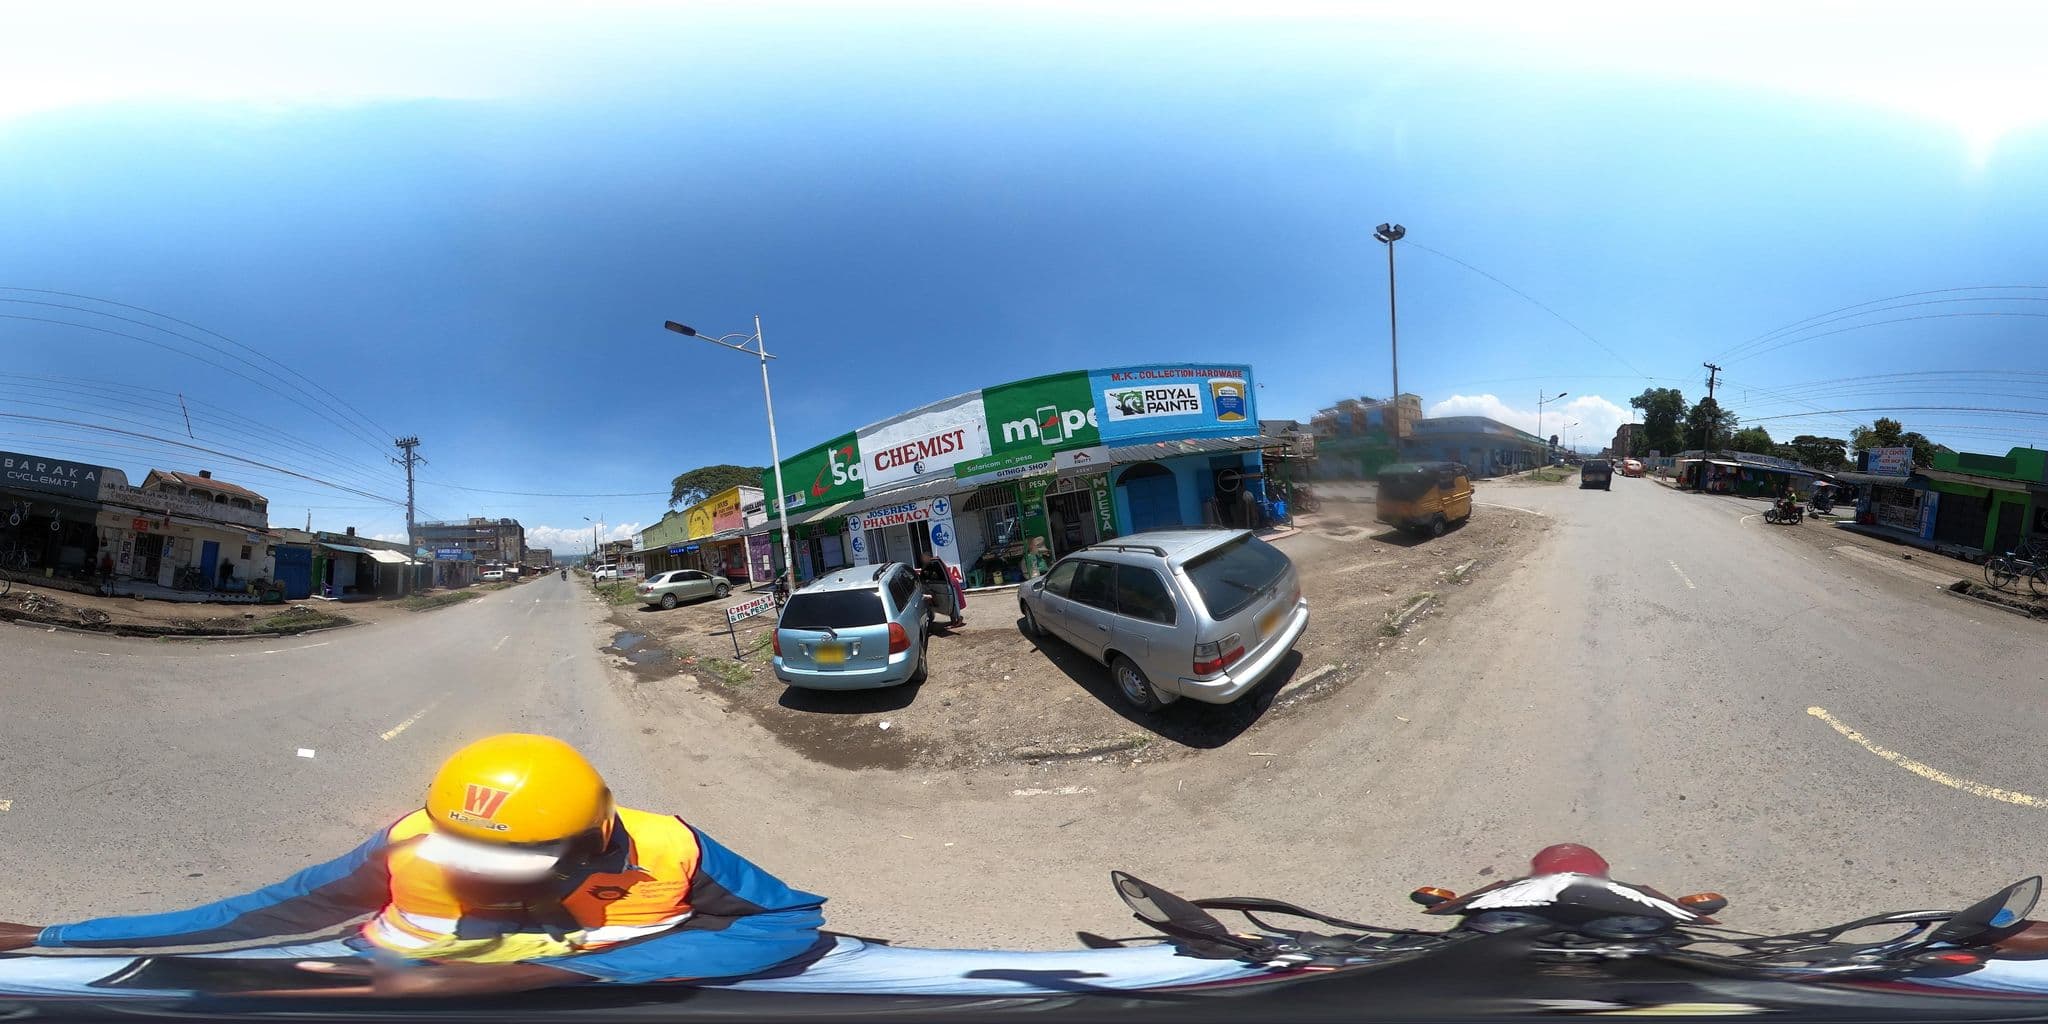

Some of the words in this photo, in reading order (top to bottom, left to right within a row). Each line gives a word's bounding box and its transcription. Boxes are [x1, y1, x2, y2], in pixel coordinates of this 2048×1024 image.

[1139, 369, 1194, 380] COLLECTION
[1195, 369, 1243, 379] HARDWARE
[1145, 388, 1196, 402] ROYAL
[1147, 400, 1199, 414] PAINTS
[874, 429, 965, 471] CHEMIST
[4, 458, 96, 482] BARAKA
[996, 467, 1027, 478] GITHIGA
[1028, 462, 1049, 473] SHOP
[7, 471, 79, 489] CYCLEMATT
[1029, 479, 1048, 489] PESA
[863, 504, 932, 529] PHARMACY
[867, 502, 918, 519] JOSERISE
[729, 595, 773, 615] CHEMIST
